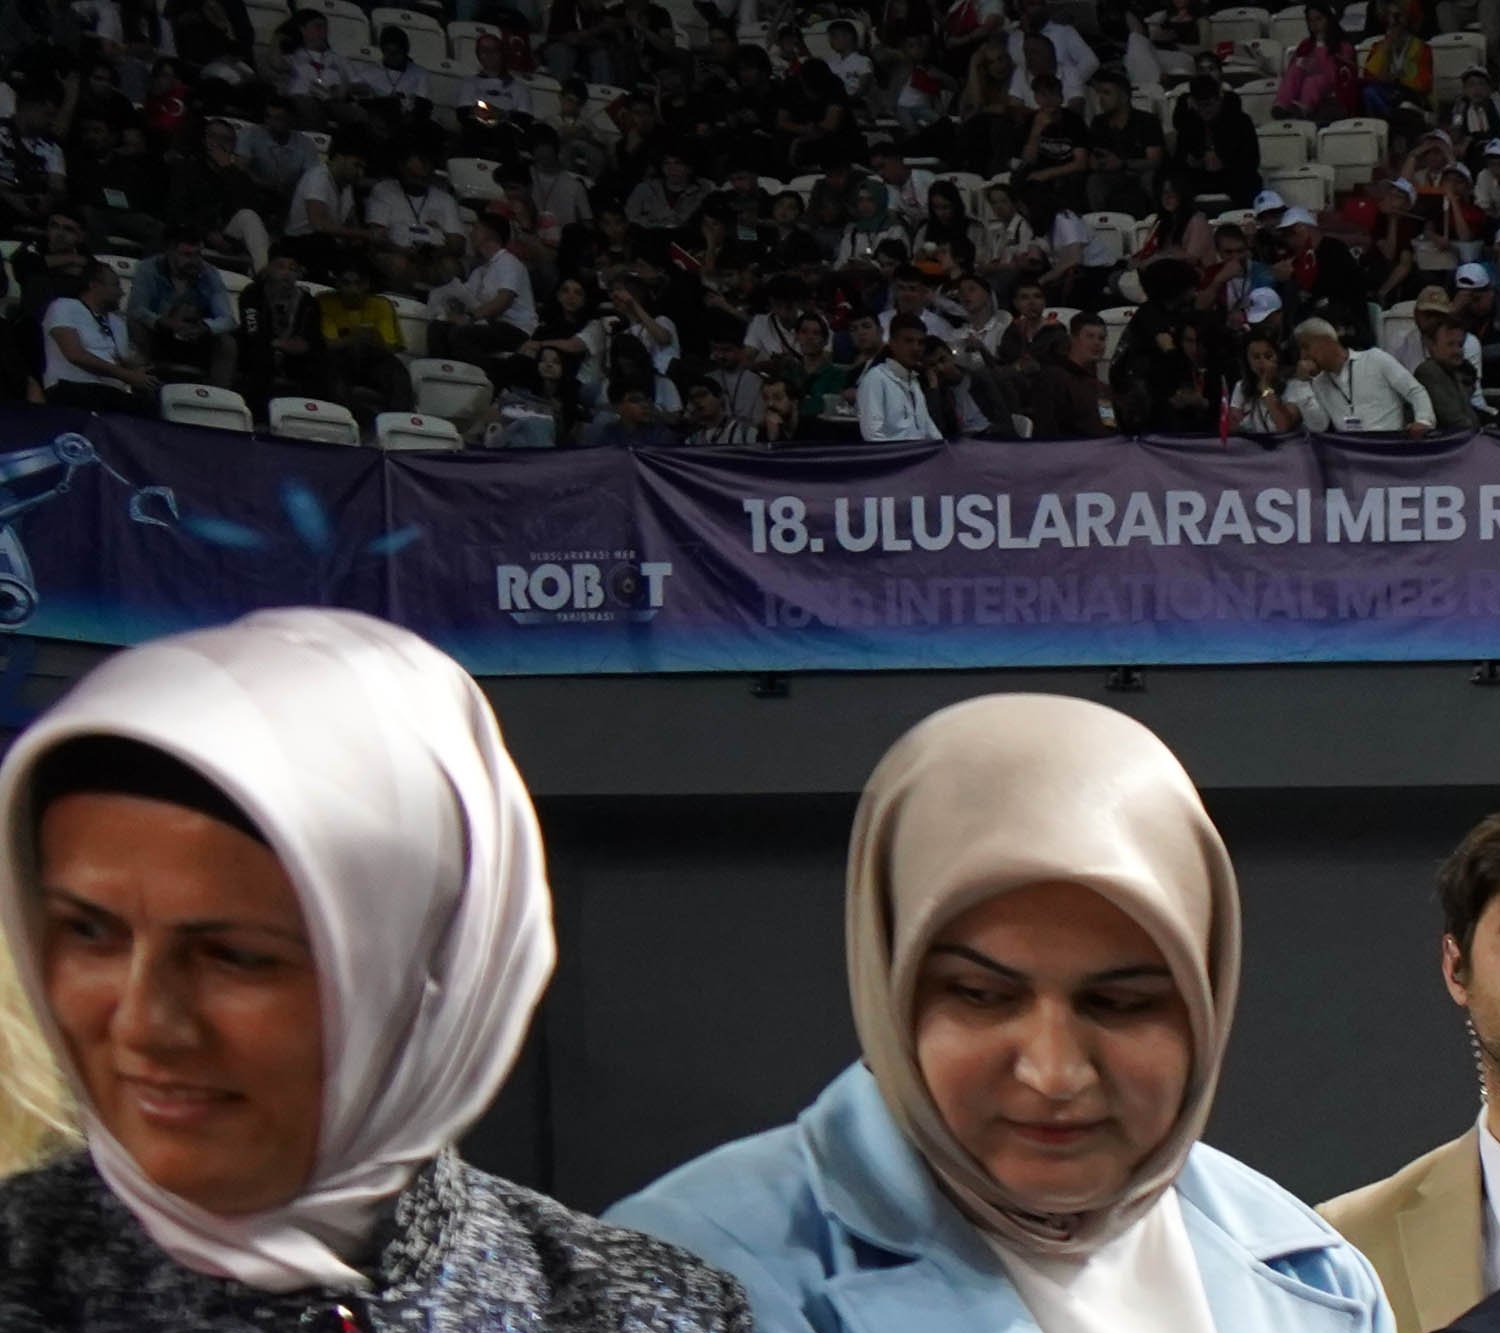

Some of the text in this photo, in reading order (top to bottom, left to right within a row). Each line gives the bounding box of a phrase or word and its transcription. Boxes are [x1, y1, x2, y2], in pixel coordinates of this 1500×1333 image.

[743, 496, 824, 554] 18.
[835, 488, 1312, 552] ULUSLARARASI
[1325, 485, 1467, 544] MEB
